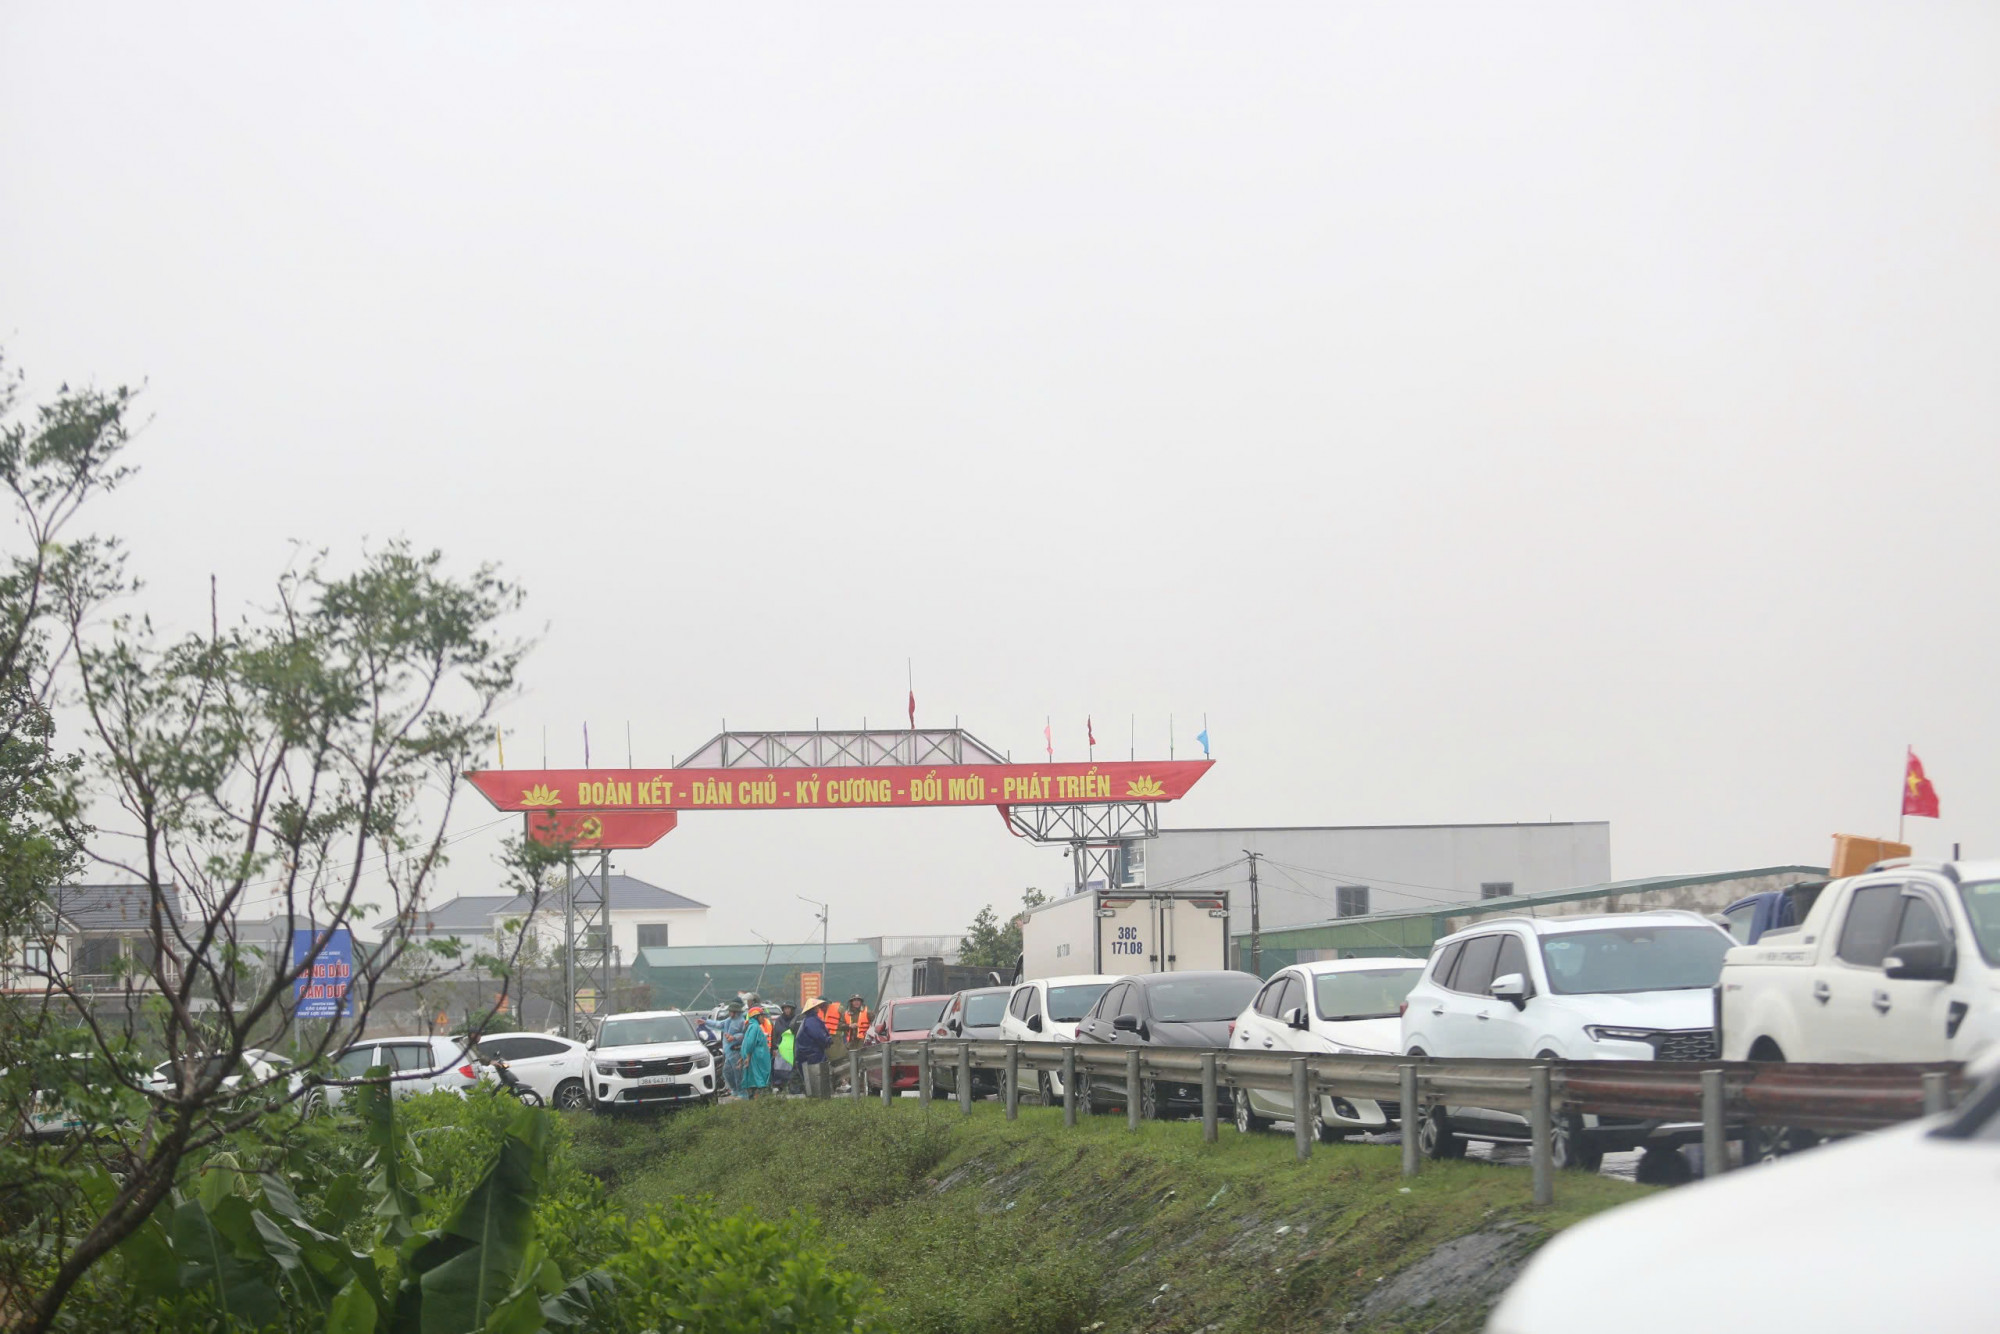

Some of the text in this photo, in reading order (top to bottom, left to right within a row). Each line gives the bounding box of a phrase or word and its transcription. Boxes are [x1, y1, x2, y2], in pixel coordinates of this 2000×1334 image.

[577, 776, 633, 806] ĐOÀN
[637, 774, 674, 805] KẾT
[691, 776, 733, 805] DÂN
[738, 773, 778, 805] CHỦ
[795, 772, 821, 805] KỶ
[826, 777, 892, 804] CƯƠNG
[909, 769, 943, 802] ĐỔI
[947, 773, 985, 801] MỚI
[1003, 772, 1052, 800] PHÁT
[1056, 766, 1111, 799] TRIỂN
[1118, 926, 1137, 940] 38C
[1111, 941, 1143, 955] 171.08
